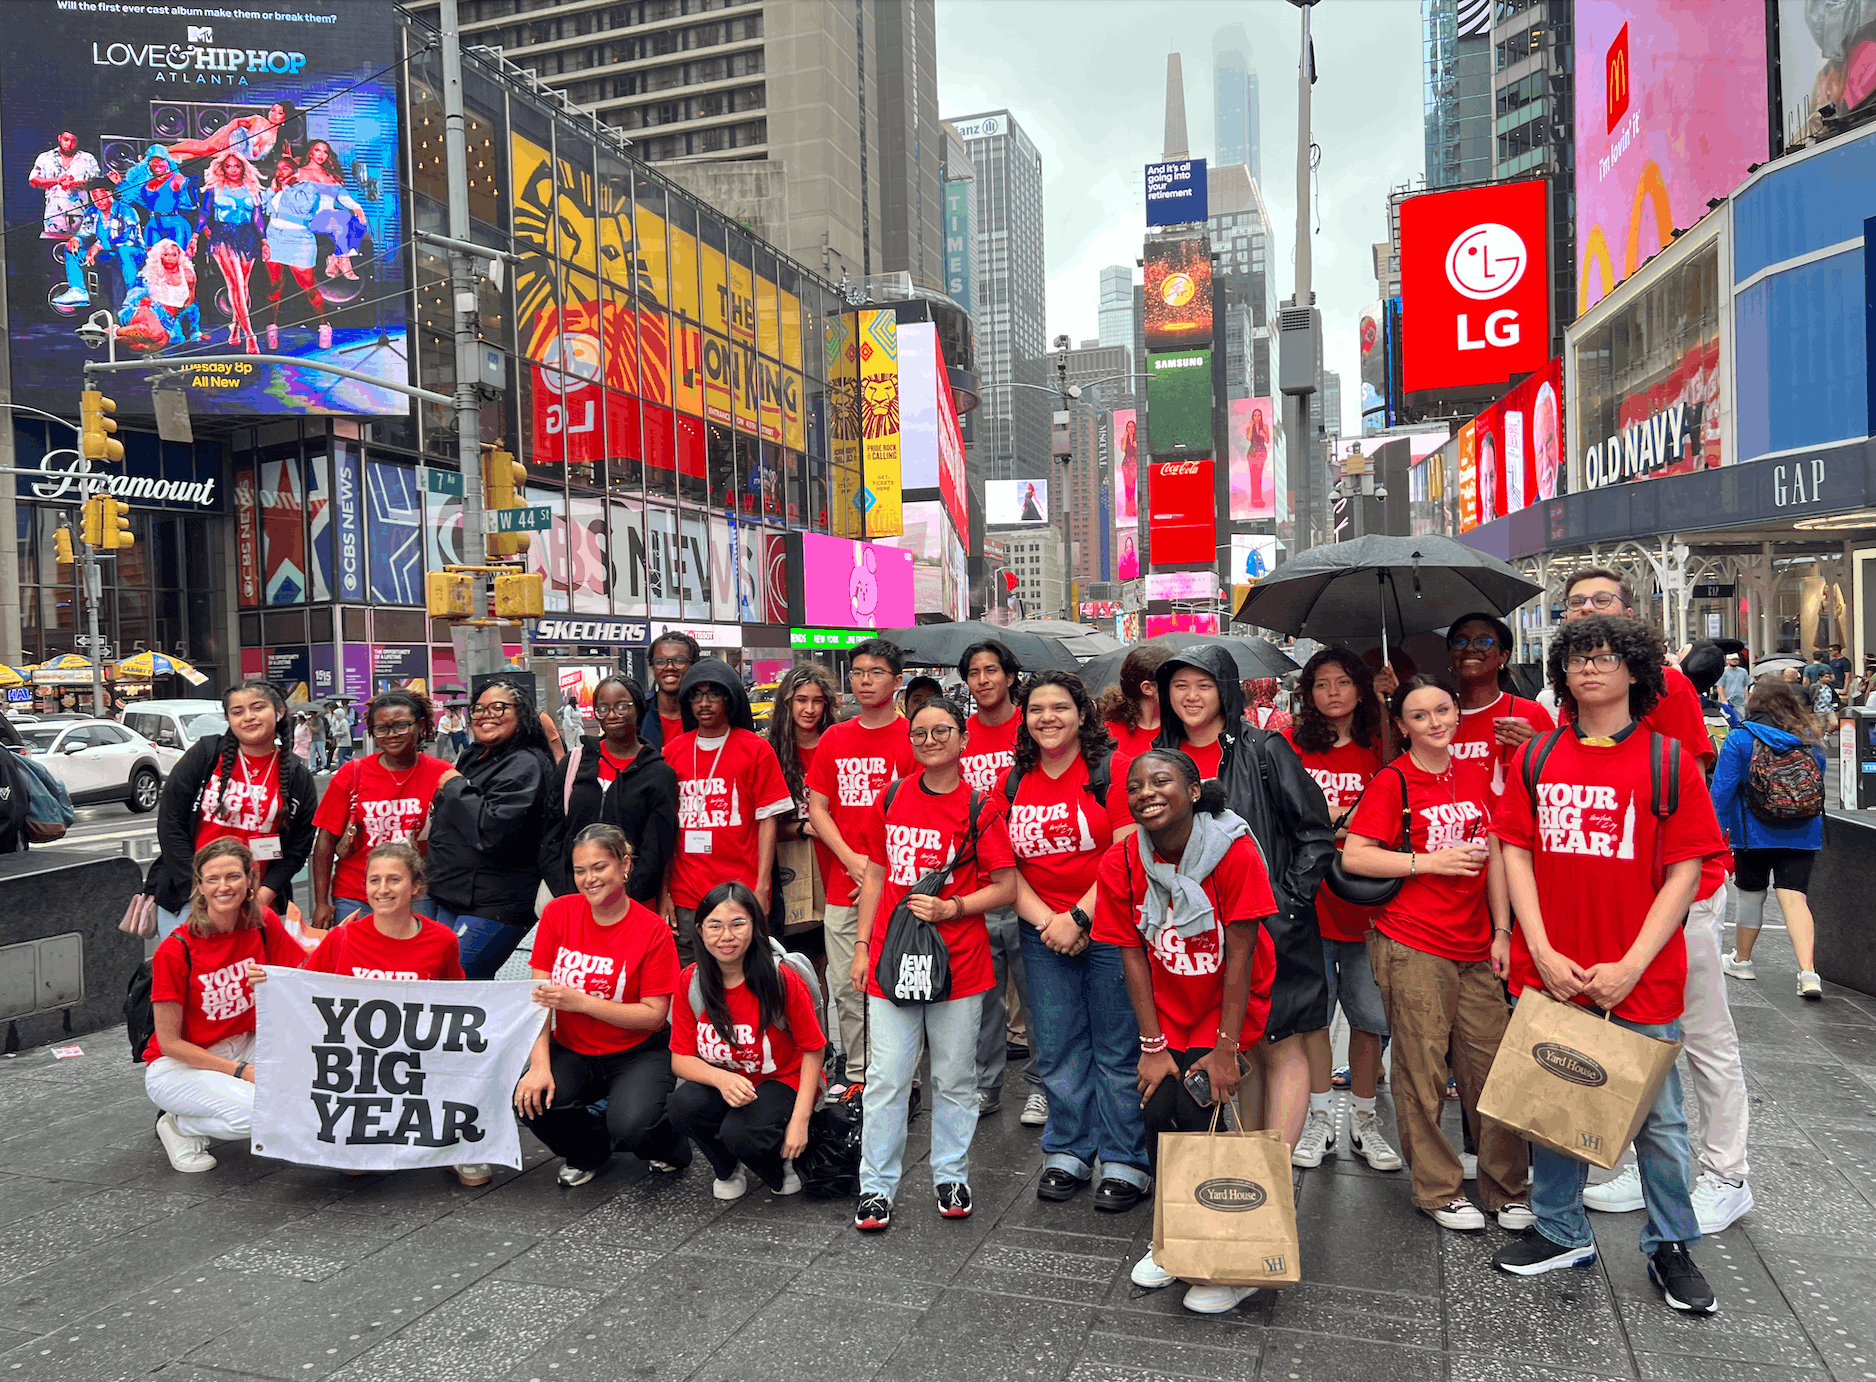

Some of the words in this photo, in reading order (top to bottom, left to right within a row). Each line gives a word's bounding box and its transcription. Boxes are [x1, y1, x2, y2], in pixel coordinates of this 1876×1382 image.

[57, 1, 76, 11] Will
[79, 2, 96, 11] the
[98, 2, 120, 13] first
[122, 5, 145, 14] ever
[147, 6, 169, 15] cast
[171, 6, 203, 16] album
[204, 9, 232, 18] make
[233, 9, 260, 20] them
[262, 12, 273, 20] or
[275, 12, 304, 22] break
[305, 14, 337, 24] them?
[155, 72, 249, 86] ATLANTA
[1610, 118, 1631, 167] lovin'
[1632, 108, 1641, 138] it
[1147, 165, 1166, 175] And
[1166, 163, 1179, 173] it's
[1180, 162, 1191, 171] all
[1148, 173, 1173, 184] going
[1173, 172, 1191, 180] into
[1148, 182, 1168, 192] your
[1148, 188, 1193, 200] retirement
[947, 195, 964, 293] TIMES
[717, 283, 753, 331] THE
[1457, 309, 1520, 351] LG
[234, 361, 253, 374] 8p
[1155, 357, 1203, 369] SAMSUNG
[192, 376, 209, 387] All
[211, 376, 241, 388] New
[743, 338, 797, 414] KING
[872, 452, 897, 460] CALLING
[1586, 435, 1621, 490] OLD
[1624, 402, 1685, 478] NAVY
[437, 473, 443, 491] 7
[1773, 459, 1826, 507] GAP
[340, 466, 354, 529] NEWS
[500, 512, 512, 529] W
[518, 510, 535, 528] 44
[541, 508, 550, 521] St
[241, 541, 252, 580] CBS
[343, 532, 357, 572] CBS
[627, 525, 755, 605] NEWS
[536, 620, 647, 641] SKECHERS
[694, 631, 714, 640] TISSOT
[813, 634, 825, 643] NEW
[826, 635, 839, 644] YORK
[315, 670, 331, 681] 1515
[835, 757, 887, 774] YOUR
[960, 750, 1017, 773] YOUR
[211, 774, 269, 801] YOUR
[678, 777, 727, 796] YOUR
[837, 774, 870, 790] BIG
[963, 769, 997, 791] BIG
[1305, 767, 1364, 792] YOUR
[202, 789, 243, 812] BG
[361, 798, 422, 818] YOUR
[679, 795, 707, 812] BIG
[1536, 783, 1618, 811] YOUR
[363, 815, 401, 833] BIG
[1011, 803, 1069, 823] YOUR
[1420, 801, 1482, 826] YOUR
[1537, 806, 1583, 831] BIG
[885, 824, 942, 850] YOUR
[1009, 822, 1044, 842] BIG
[1427, 821, 1464, 845] BIG
[886, 843, 916, 867] BIG
[1153, 929, 1186, 954] IG
[556, 946, 614, 976] YOUR
[900, 953, 932, 971] NEW
[551, 963, 586, 990] BIG
[201, 982, 243, 1008] BIG
[201, 992, 255, 1021] YEA
[312, 996, 488, 1053] YOUR
[697, 1021, 755, 1045] YOR
[697, 1039, 733, 1061] BIG
[311, 1045, 426, 1096] BIG
[1545, 1049, 1567, 1067] Yard
[1566, 1059, 1596, 1079] House
[310, 1091, 485, 1148] YEAR
[1580, 1132, 1600, 1151] YH
[1207, 1188, 1227, 1200] Yard
[1229, 1188, 1256, 1201] House
[1263, 1255, 1284, 1273] YH
